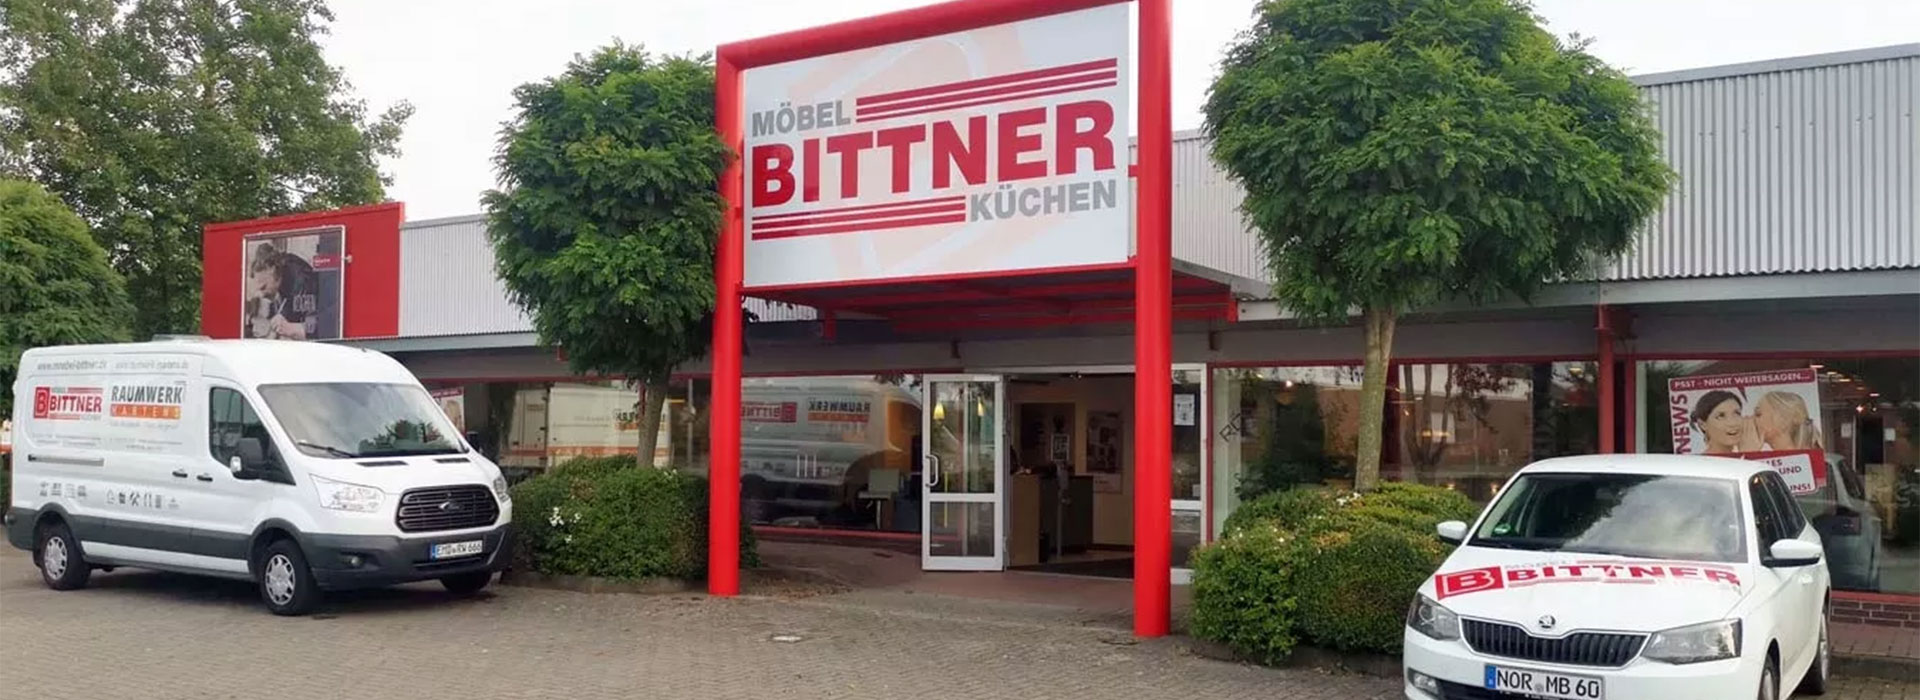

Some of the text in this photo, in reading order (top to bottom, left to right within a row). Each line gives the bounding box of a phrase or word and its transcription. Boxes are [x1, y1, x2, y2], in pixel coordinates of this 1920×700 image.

[752, 100, 851, 137] MÖBEL
[752, 99, 1115, 208] BITTNER
[970, 178, 1117, 222] KÜCHEN
[1674, 380, 1696, 388] PSST
[1703, 376, 1732, 387] NICHT
[50, 395, 102, 413] BITTNER
[111, 386, 183, 404] RAUMWERK
[1672, 394, 1692, 455] NEWS
[1779, 466, 1802, 474] UND
[468, 542, 482, 552] 666
[1507, 564, 1741, 586] BITTNER
[1497, 669, 1600, 699] NOR MB 60
